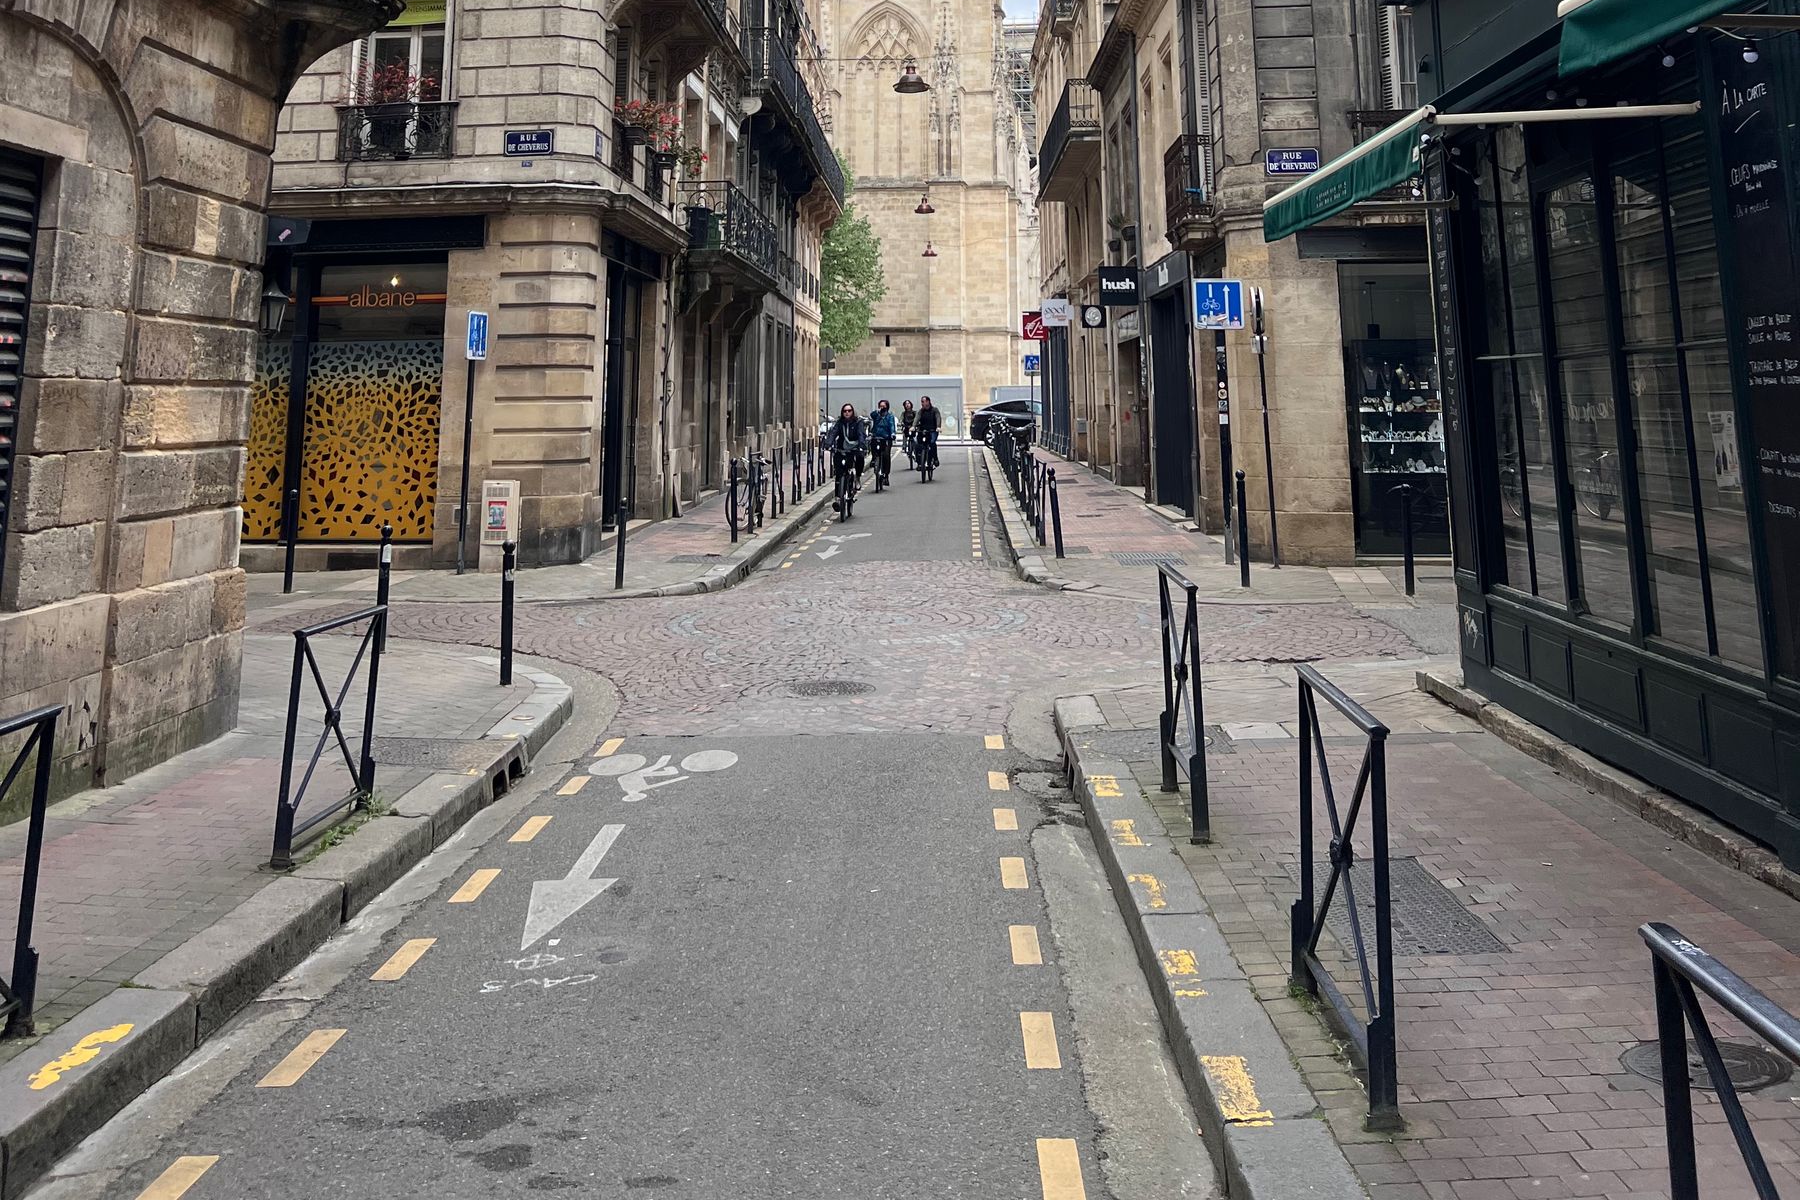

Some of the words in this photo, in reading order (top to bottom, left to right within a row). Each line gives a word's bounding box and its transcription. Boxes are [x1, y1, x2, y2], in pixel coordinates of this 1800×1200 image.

[1746, 82, 1767, 102] CARTE
[520, 134, 537, 142] RUE
[508, 144, 516, 152] DE
[517, 143, 549, 151] CHEVERUS
[1282, 152, 1302, 160] RUE
[1269, 162, 1279, 171] DE
[1281, 162, 1317, 170] CHEVERUS
[1102, 278, 1135, 290] hush
[350, 285, 415, 308] albane
